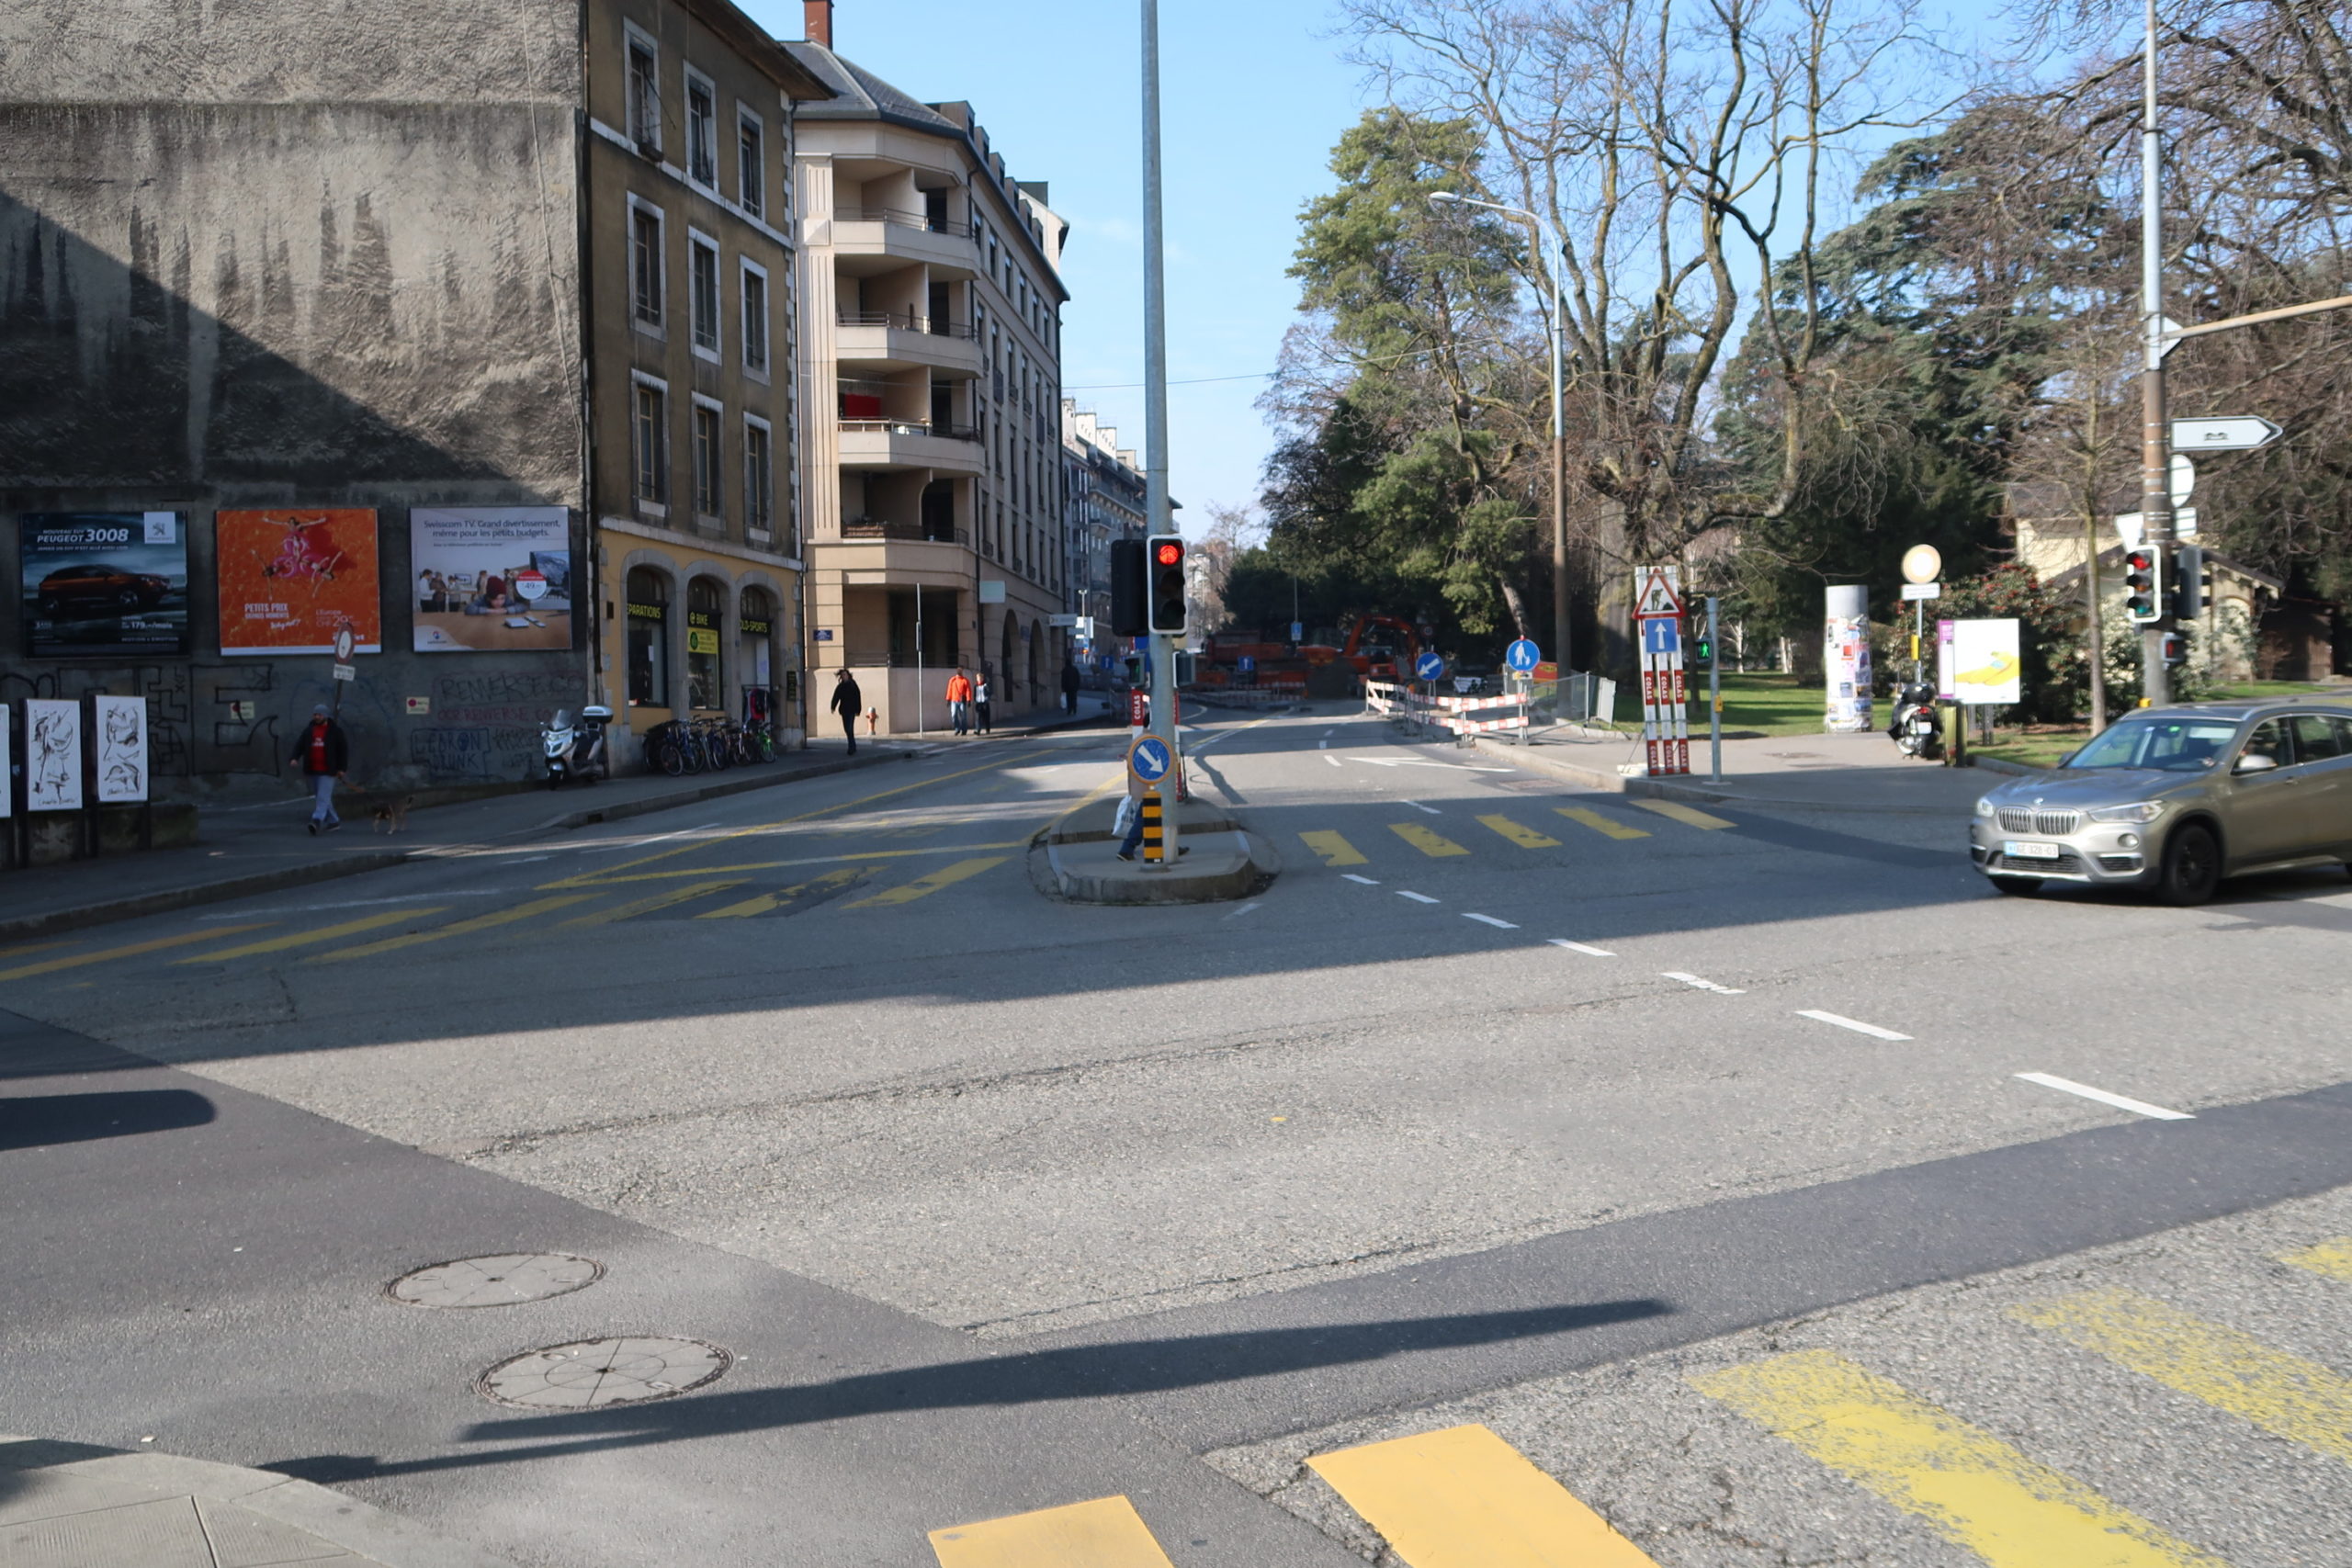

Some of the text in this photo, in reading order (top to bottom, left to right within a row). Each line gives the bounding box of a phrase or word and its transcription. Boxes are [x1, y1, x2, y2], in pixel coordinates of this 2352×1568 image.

[424, 519, 462, 529] Swisscom
[478, 519, 502, 528] Grand
[37, 528, 130, 543] PEUGEOT 3008
[433, 528, 549, 539] même pour les petits budgets.
[244, 602, 288, 613] PETITS PRIX
[696, 614, 708, 626] BIKE
